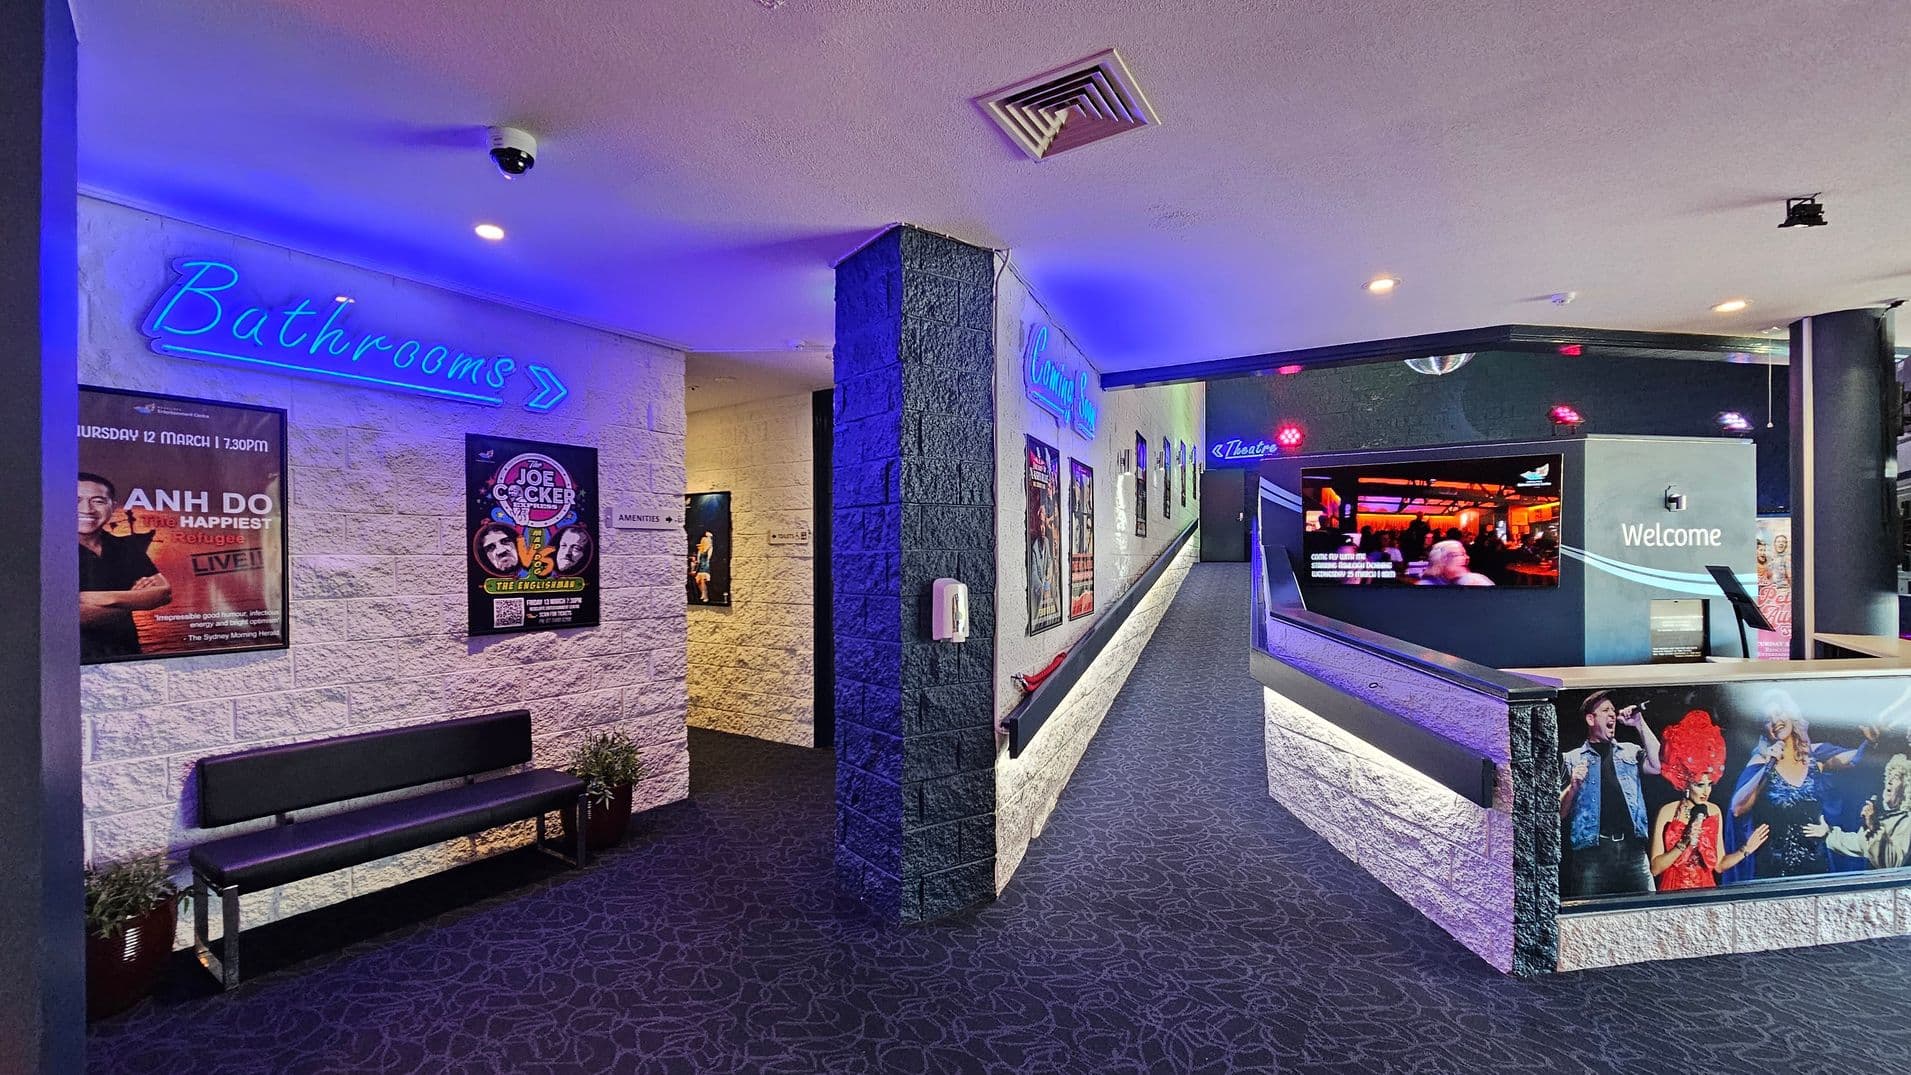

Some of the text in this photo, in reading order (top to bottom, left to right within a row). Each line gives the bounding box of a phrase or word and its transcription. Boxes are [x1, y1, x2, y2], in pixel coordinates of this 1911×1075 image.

[153, 261, 515, 389] Bathrooms
[1031, 326, 1074, 423] Coming
[143, 430, 156, 444] 12
[160, 431, 211, 448] MARCH
[223, 437, 269, 453] 7.30PM
[1225, 439, 1278, 459] Theatre
[516, 468, 555, 487] JOE
[123, 488, 273, 515] ANH DO
[143, 515, 273, 530] The HAPPIEST
[618, 514, 660, 523] AMENITIES
[174, 531, 246, 546] Refugee
[1621, 522, 1722, 547] Welcome
[496, 580, 576, 591] THE ENGLISHMAN
[190, 621, 214, 629] energy
[229, 619, 249, 628] bright
[202, 611, 220, 620] good
[203, 633, 229, 641] Sydney
[230, 631, 257, 639] Morning
[258, 629, 280, 637] Herald
